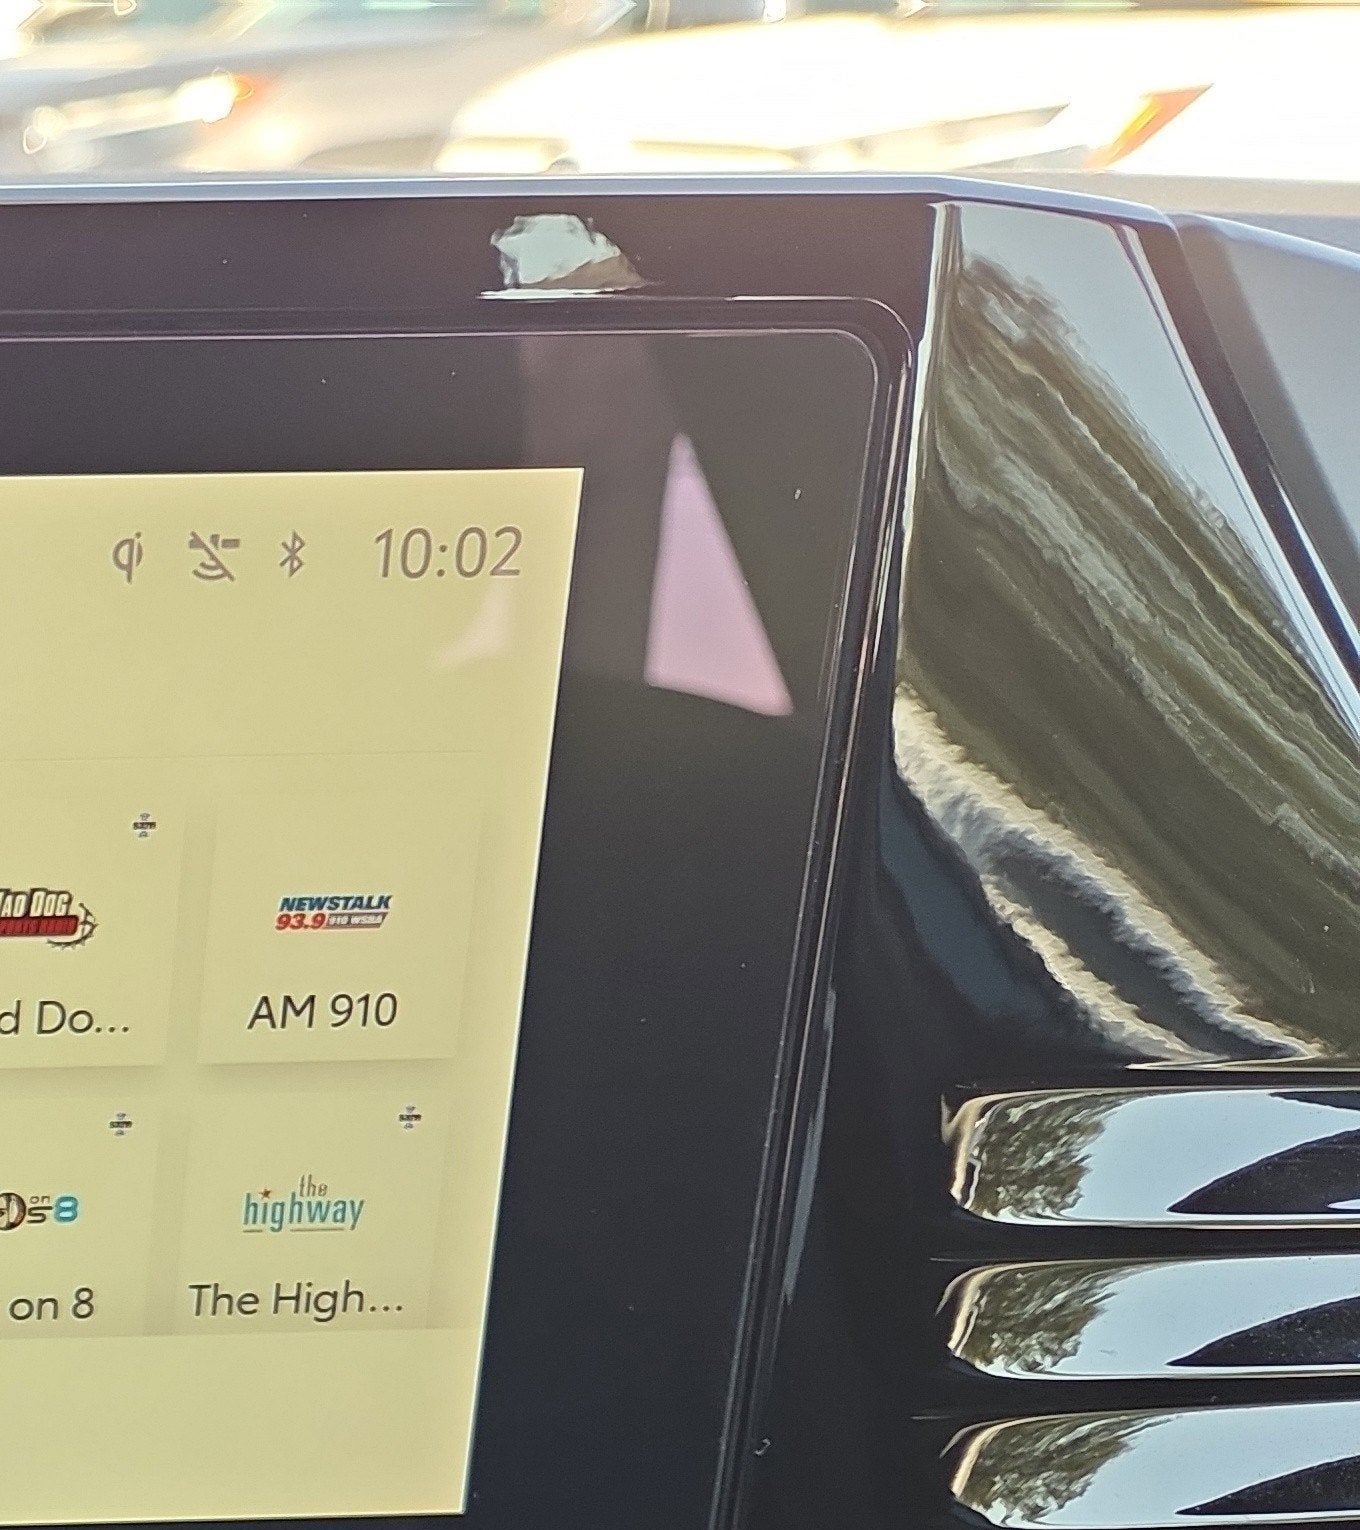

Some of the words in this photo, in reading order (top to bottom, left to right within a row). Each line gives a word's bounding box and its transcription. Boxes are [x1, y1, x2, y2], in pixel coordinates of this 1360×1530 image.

[374, 526, 522, 579] 10:02
[29, 890, 71, 917] DOG
[280, 895, 392, 911] NEWSTALK
[276, 913, 326, 930] 93.9
[36, 1000, 129, 1035] Do...
[247, 994, 316, 1030] AM
[330, 992, 398, 1028] 910
[298, 1173, 329, 1198] the
[242, 1191, 366, 1233] highway
[9, 1297, 59, 1321] on
[72, 1287, 95, 1320] 8
[188, 1282, 260, 1317] The
[273, 1279, 403, 1323] High...
